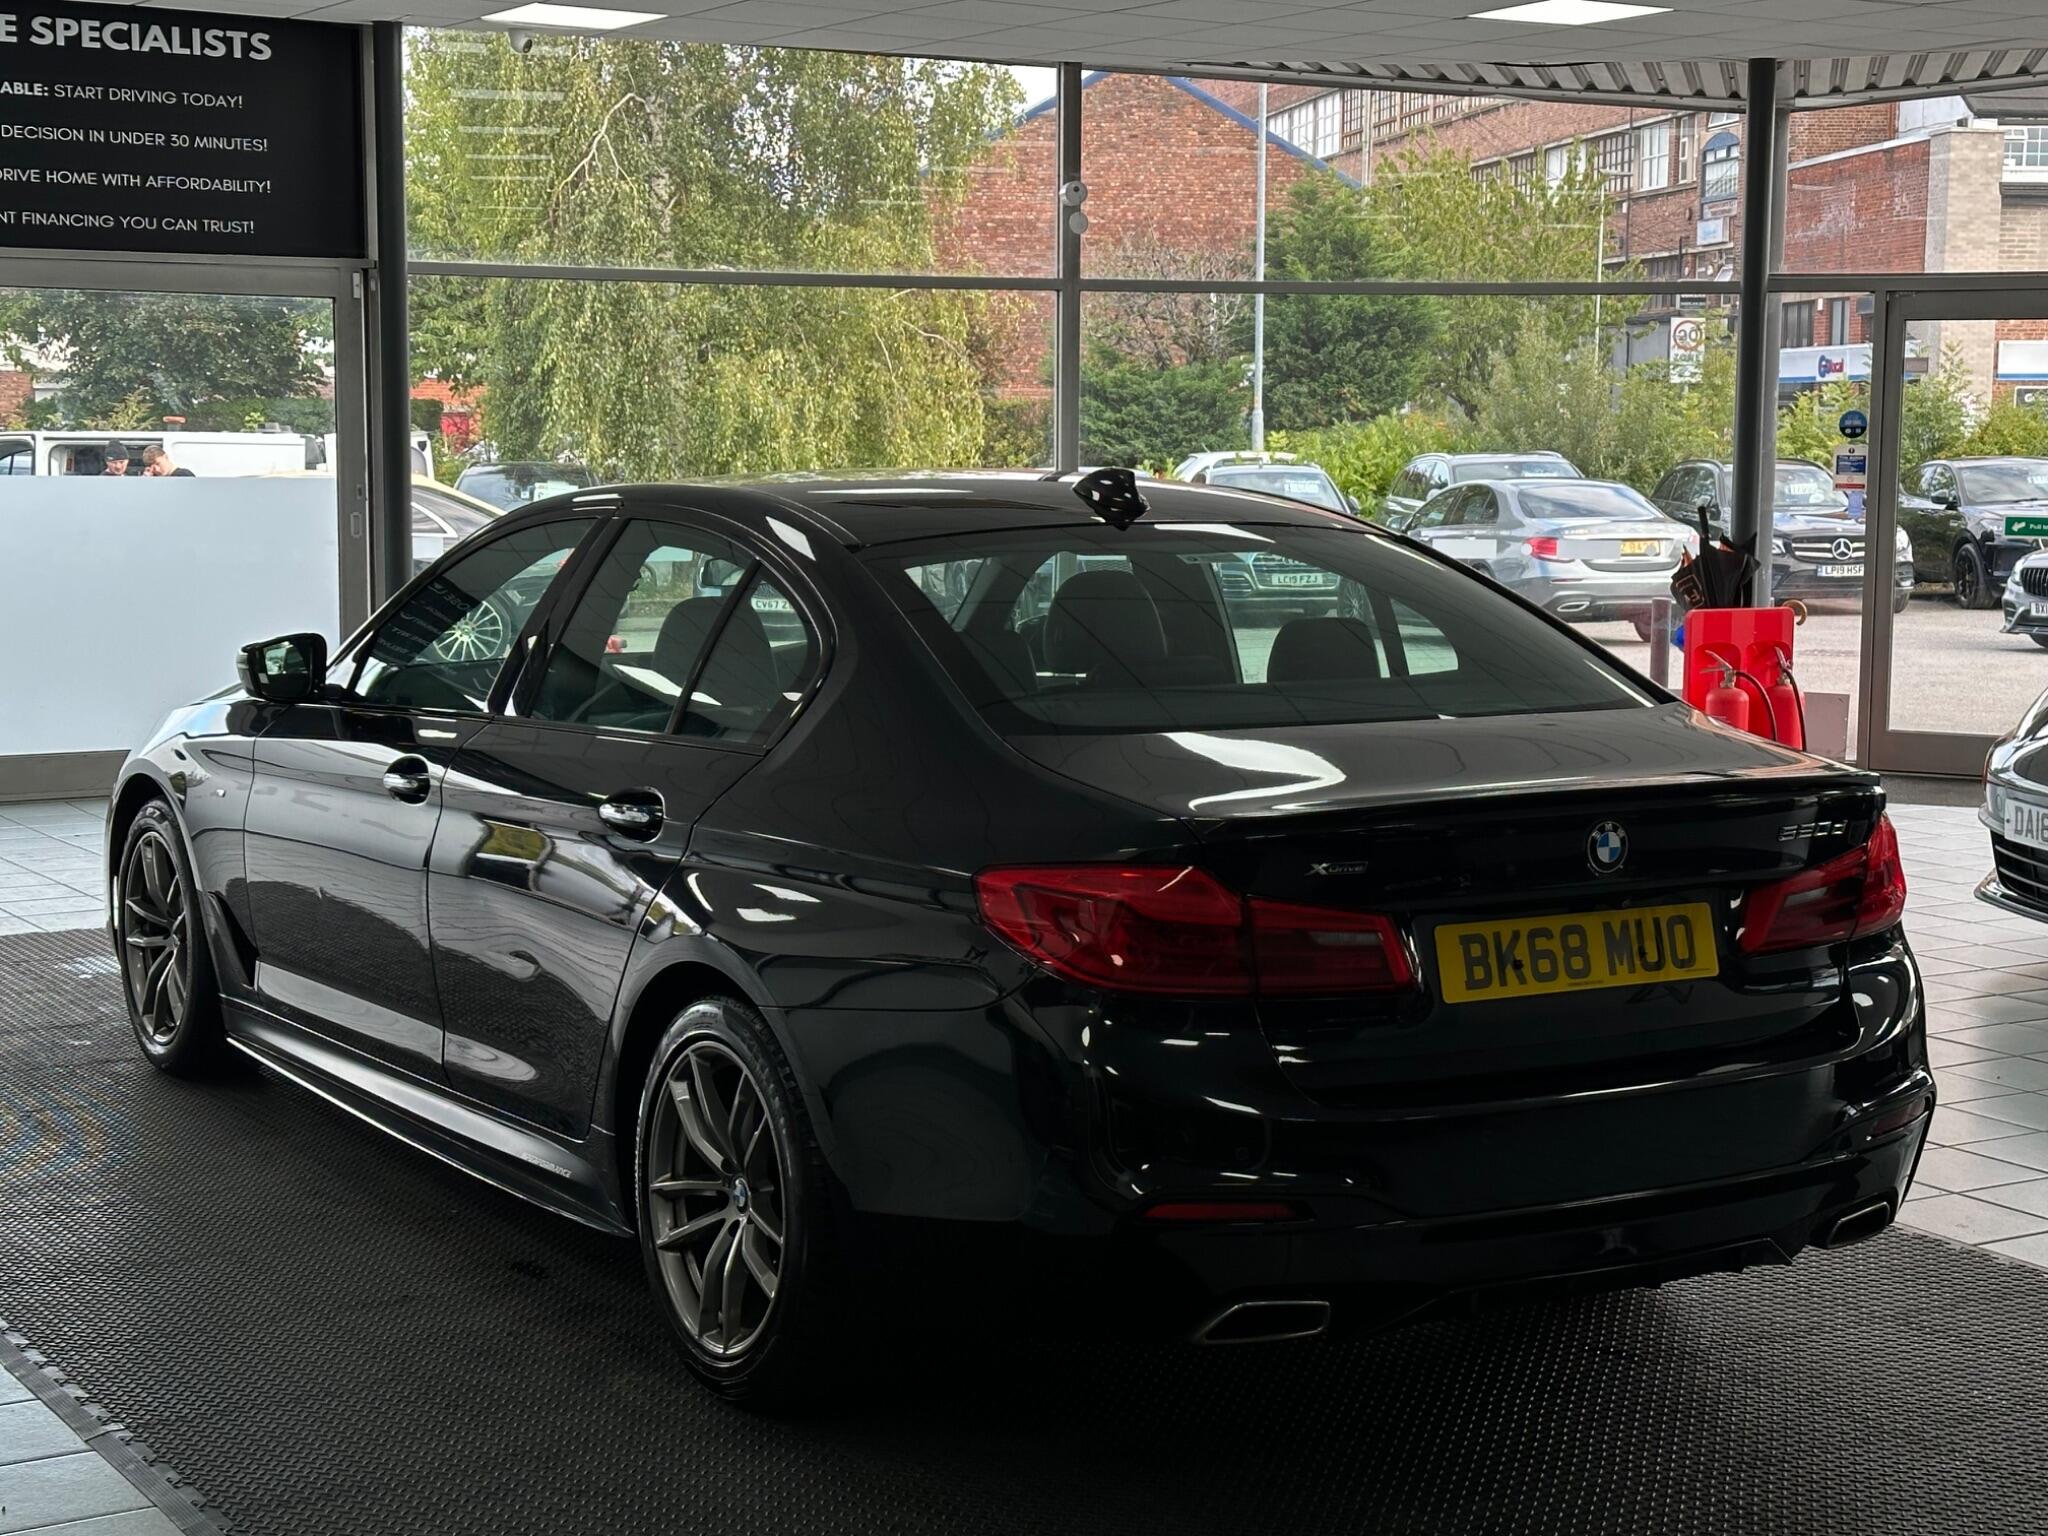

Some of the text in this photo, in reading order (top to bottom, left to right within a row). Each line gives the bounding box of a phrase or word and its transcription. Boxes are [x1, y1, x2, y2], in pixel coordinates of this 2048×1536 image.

[0, 13, 272, 60] E SPECIALISTS
[0, 81, 243, 109] ABLE: START DRIVING TODAY!
[1, 125, 268, 152] DECISION IN UNDER 30 MINUTES!
[0, 168, 271, 194] RIVE HOME WITH AFFORDABILITY!
[22, 211, 114, 228] FINANCING
[119, 216, 157, 230] YOU
[162, 217, 197, 231] CAN
[202, 219, 254, 234] TRUST!
[1278, 575, 1318, 584] LC19 FZJ
[1825, 566, 1846, 575] LP19
[1458, 914, 1698, 991] BK68 MUO
